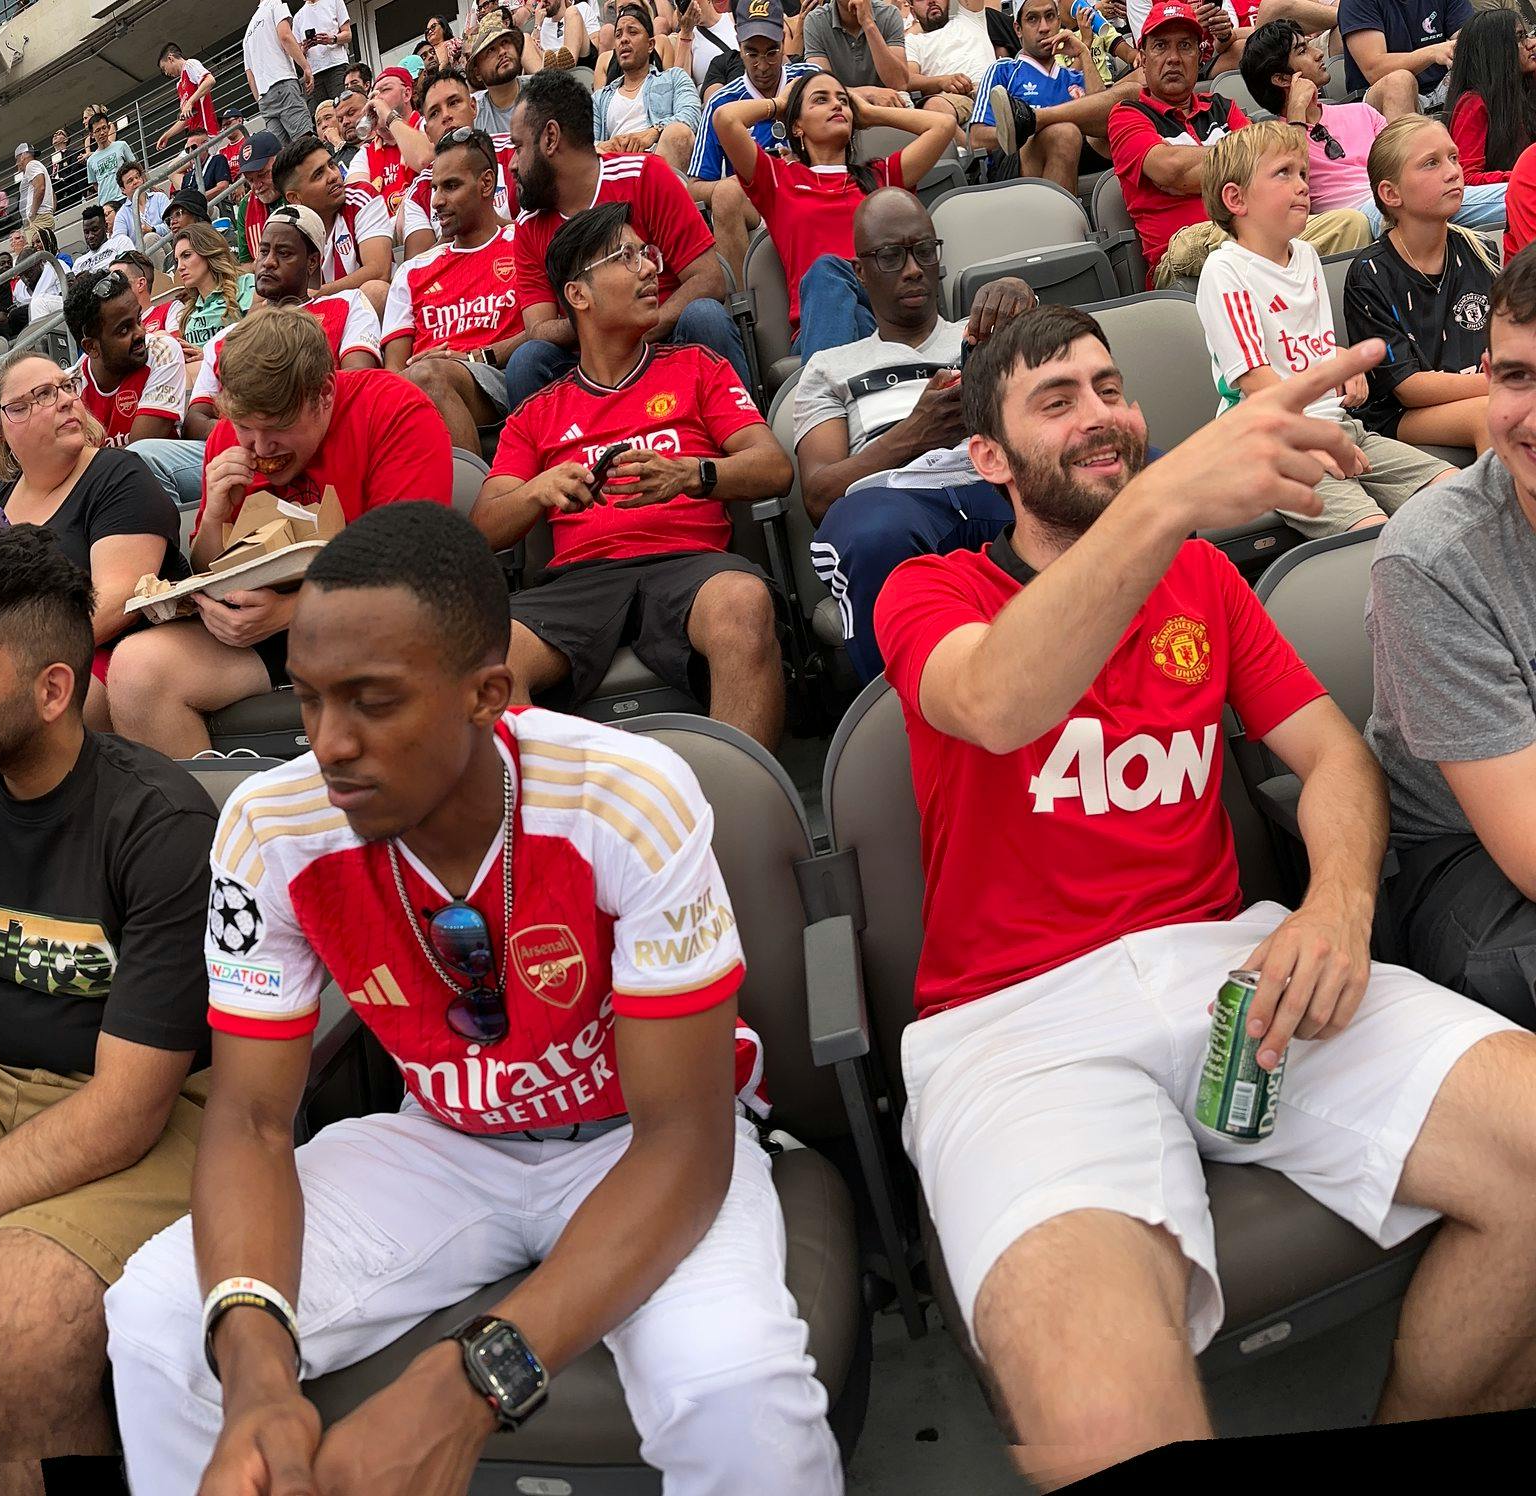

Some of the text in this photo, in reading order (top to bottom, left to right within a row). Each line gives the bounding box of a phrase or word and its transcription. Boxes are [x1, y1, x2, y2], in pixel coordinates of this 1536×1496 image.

[422, 289, 517, 329] Emirates
[1157, 619, 1205, 648] MANCHESTER
[1175, 663, 1207, 678] UNITED
[1028, 717, 1218, 816] AON
[519, 938, 569, 961] Arsenal
[404, 990, 616, 1111] mirates
[481, 1053, 615, 1125] BETTER
